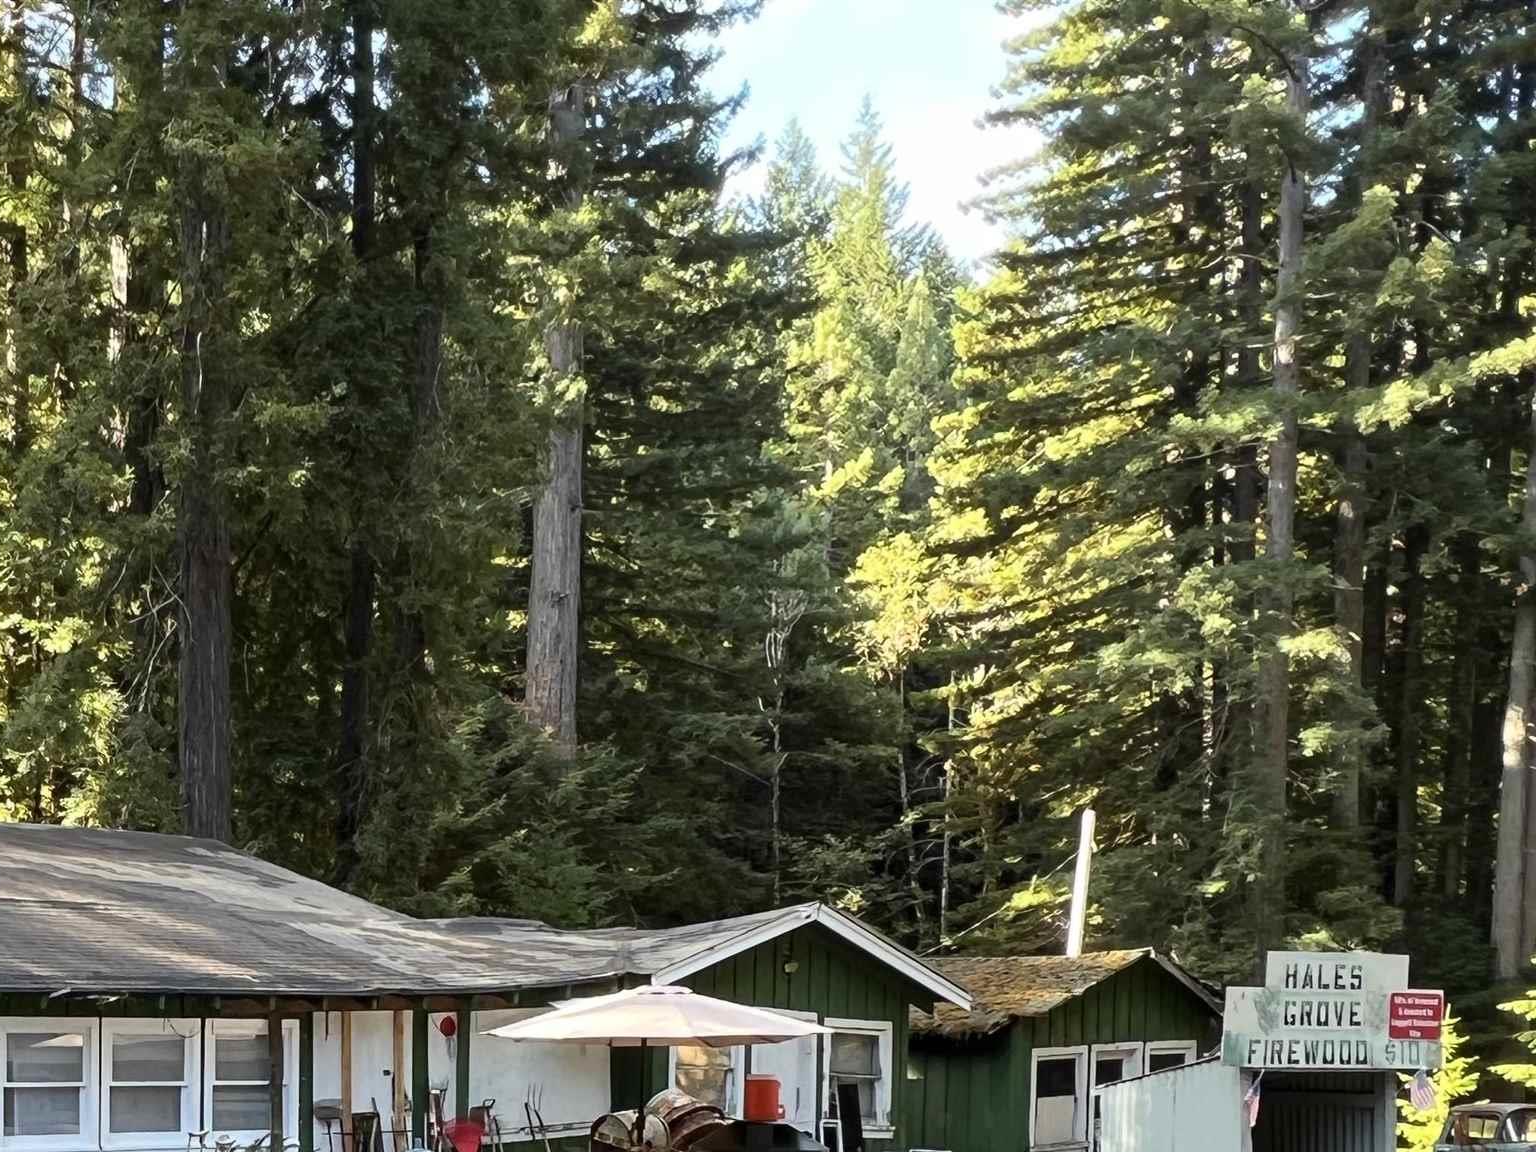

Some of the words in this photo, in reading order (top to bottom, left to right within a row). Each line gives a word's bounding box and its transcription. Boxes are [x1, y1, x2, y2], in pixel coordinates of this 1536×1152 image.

[1285, 964, 1362, 989] HALES
[1284, 1000, 1362, 1027] GROVE
[1248, 1039, 1368, 1065] FIREWOOD
